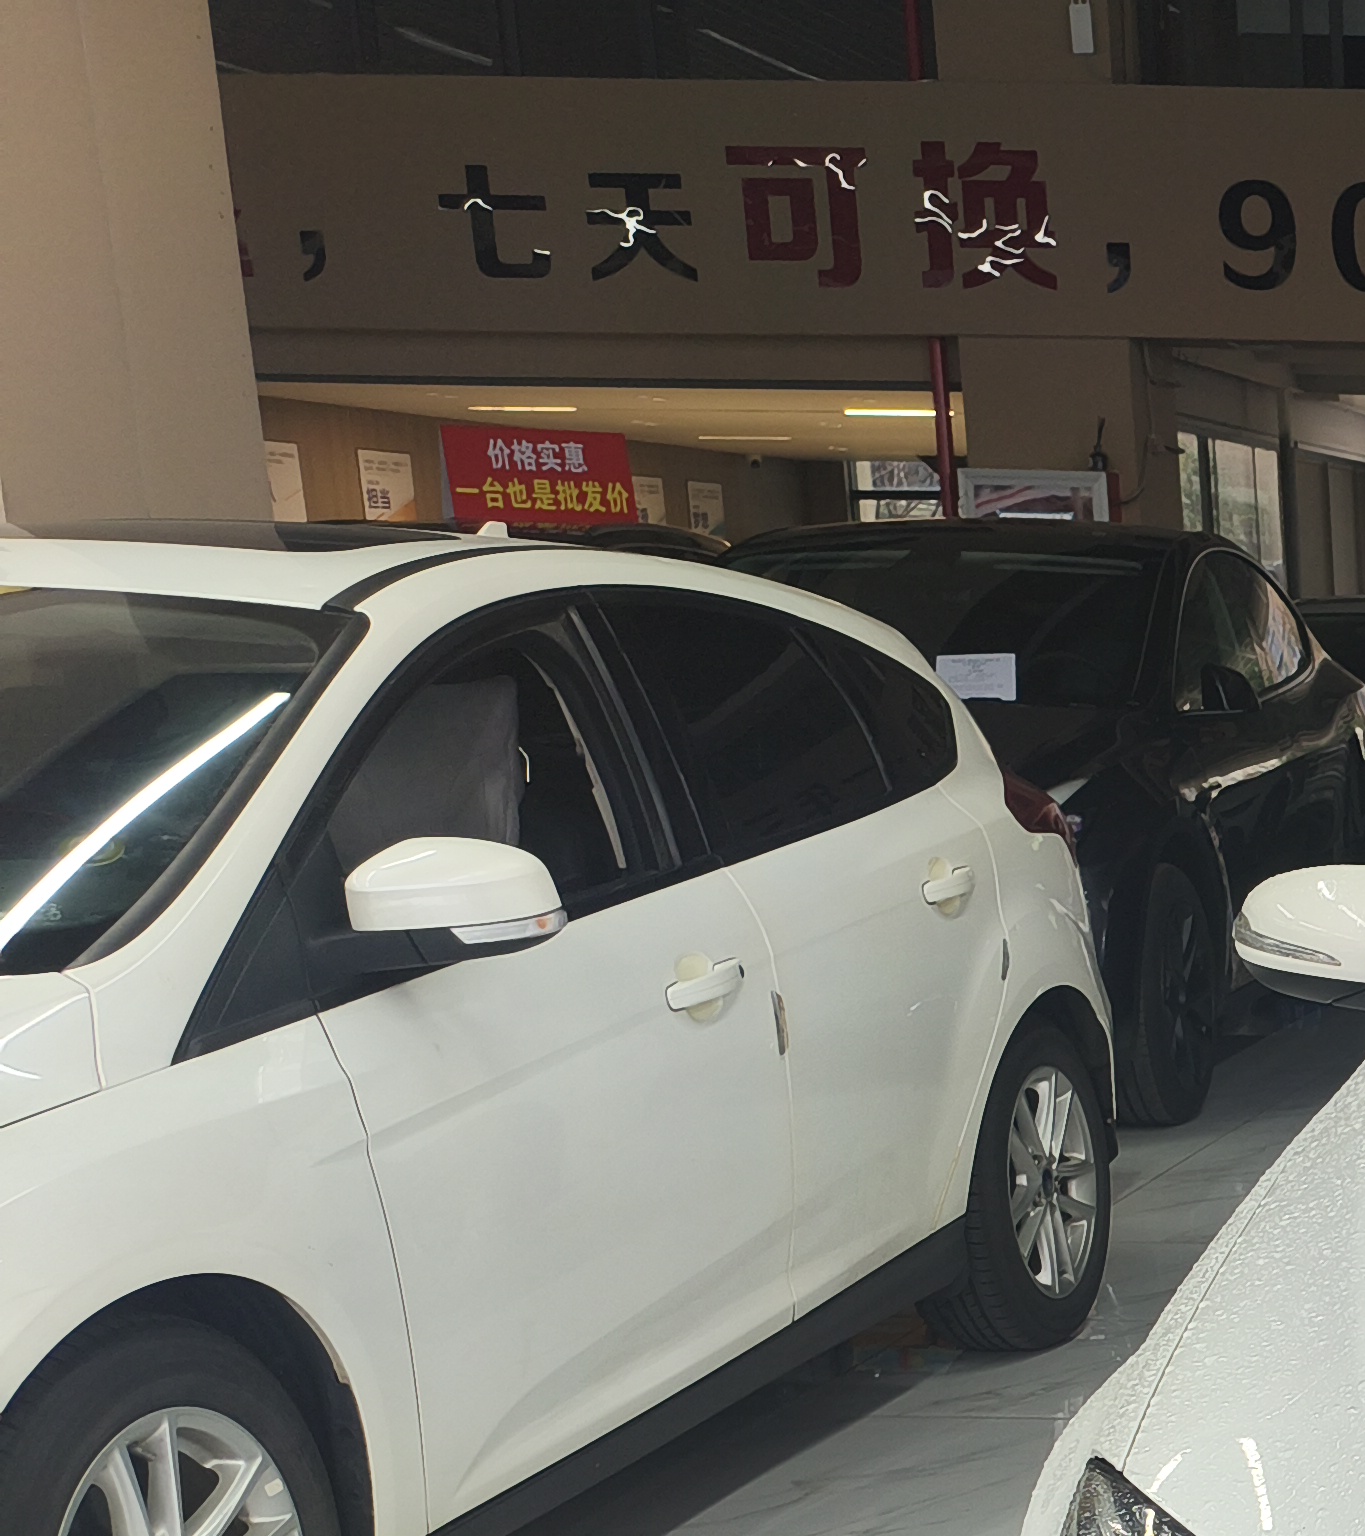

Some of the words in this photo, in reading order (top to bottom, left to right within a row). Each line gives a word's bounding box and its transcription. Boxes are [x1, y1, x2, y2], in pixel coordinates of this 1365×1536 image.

[487, 438, 588, 473] 价格实惠
[366, 487, 391, 510] 担当
[455, 477, 629, 514] 一台也是批发价
